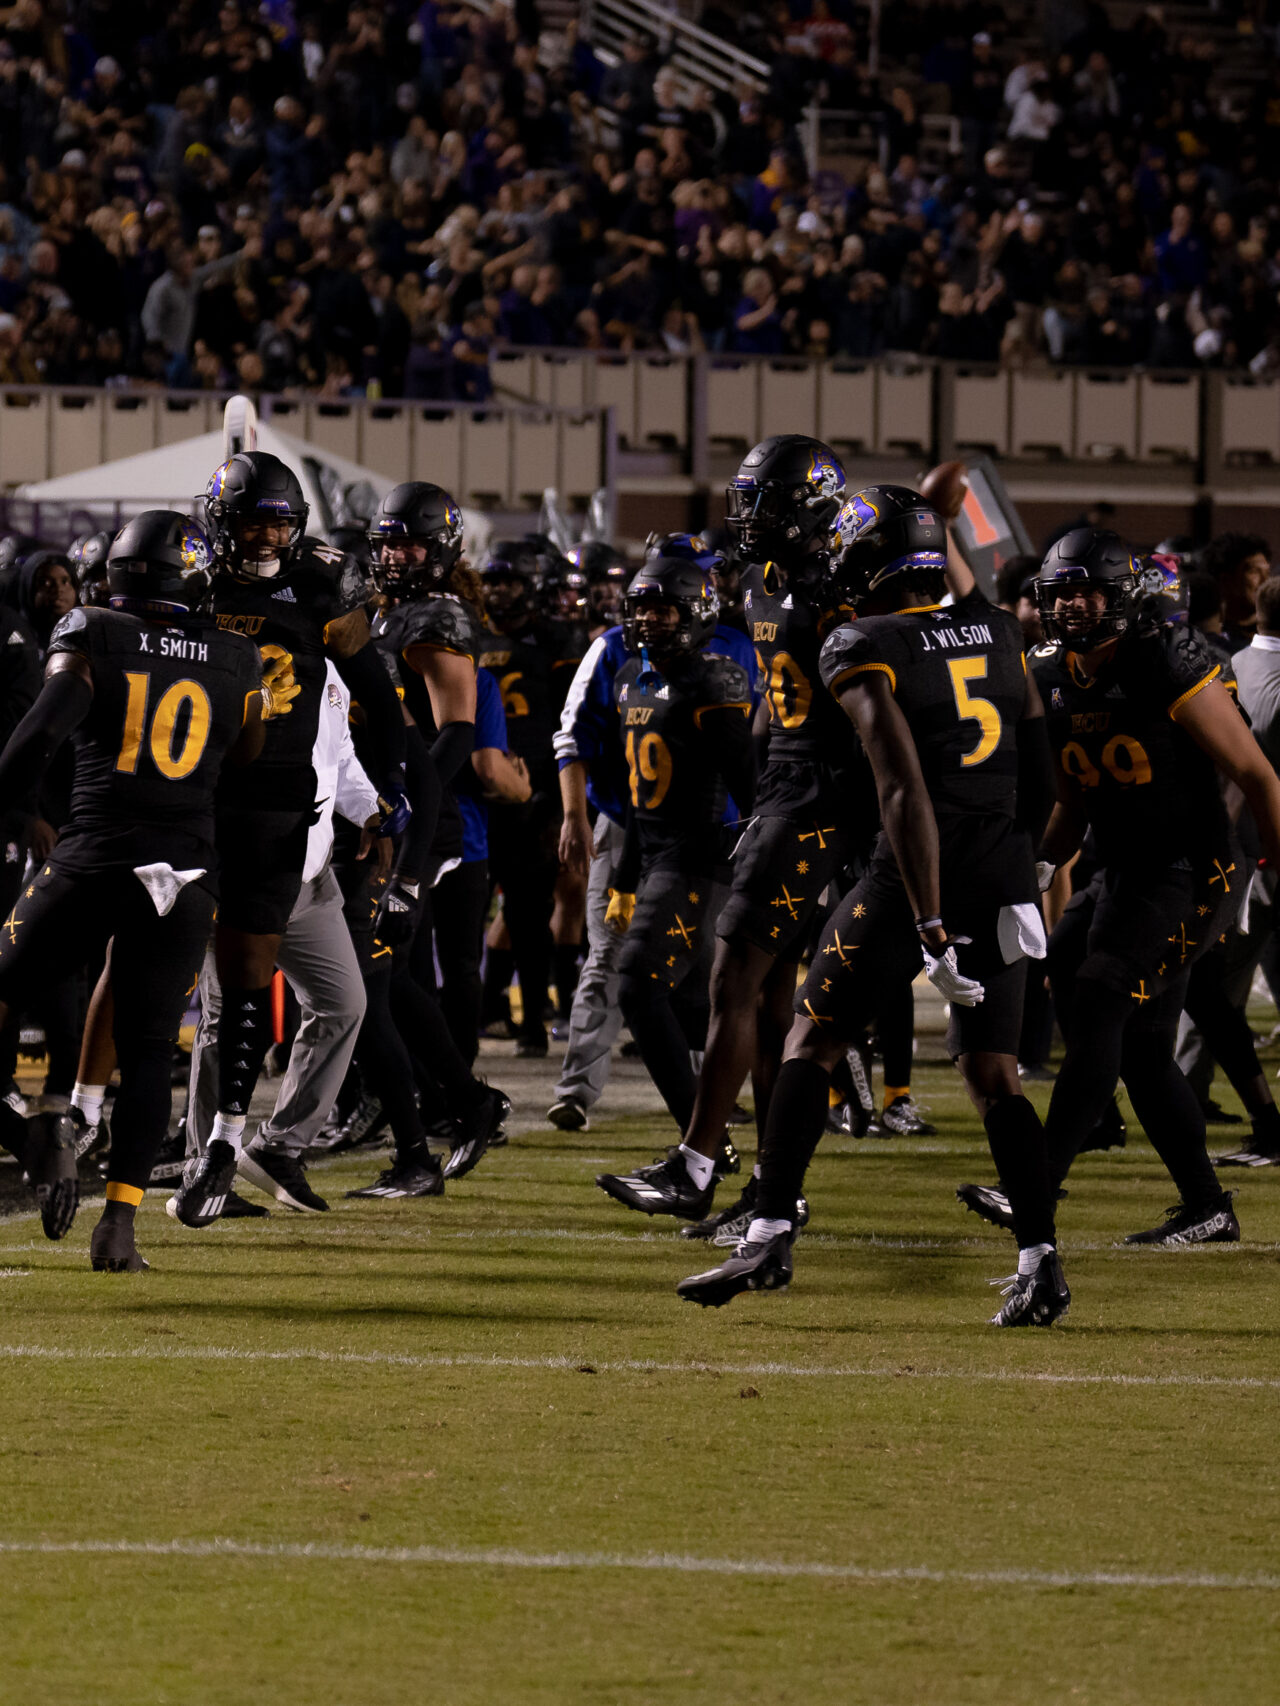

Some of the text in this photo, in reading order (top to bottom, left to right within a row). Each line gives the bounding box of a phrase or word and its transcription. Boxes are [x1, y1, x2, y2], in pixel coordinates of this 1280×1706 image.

[216, 613, 268, 636] ECU
[753, 622, 779, 642] ECU
[139, 632, 208, 662] X. SMITH
[625, 707, 654, 725] ECU
[946, 653, 1002, 767] 5
[112, 669, 213, 780] 10
[1072, 712, 1111, 734] ECU
